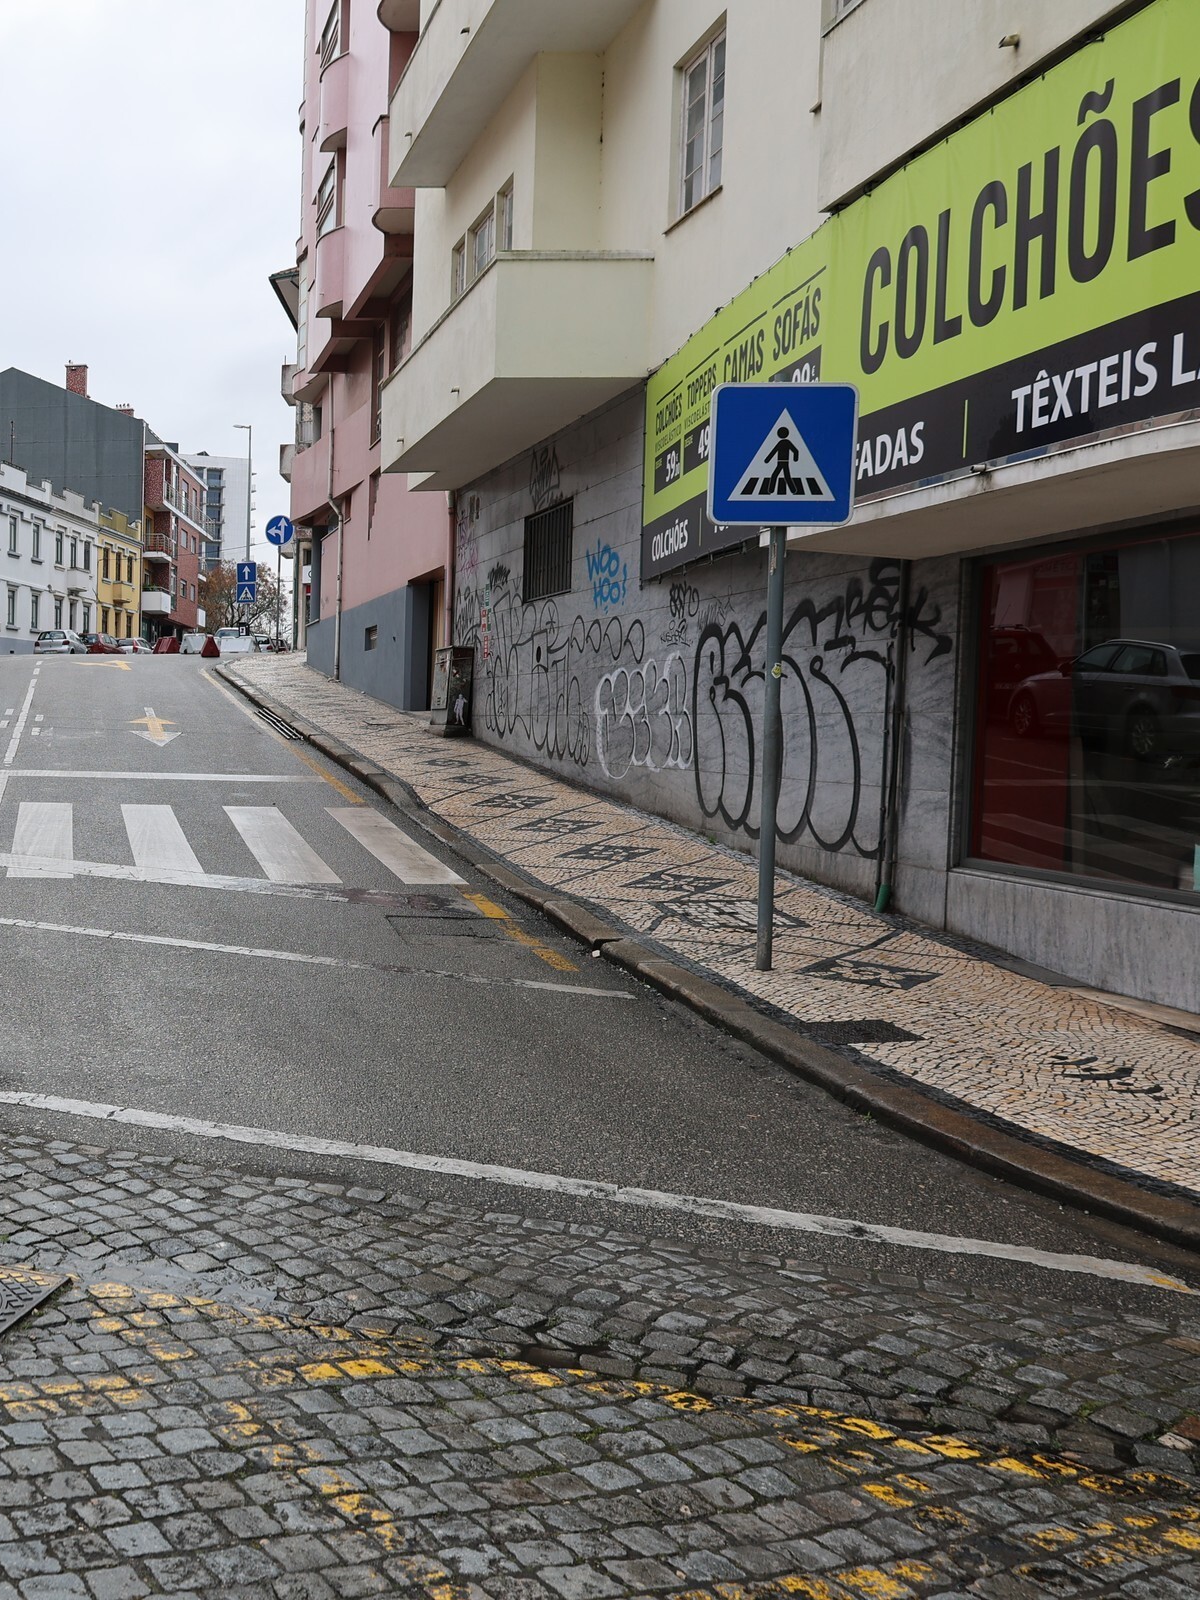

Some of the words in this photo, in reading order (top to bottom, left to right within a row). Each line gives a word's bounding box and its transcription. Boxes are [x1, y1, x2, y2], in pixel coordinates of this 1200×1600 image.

[772, 285, 822, 361] SOFÁS
[723, 328, 765, 385] CAMAS
[686, 363, 717, 409] TOPPERS
[1011, 342, 1158, 433] TÊXTEIS
[1171, 332, 1200, 387] L
[655, 392, 683, 436] COLCHÕES
[586, 538, 620, 582] WOO
[651, 518, 689, 561] COLCHÕES
